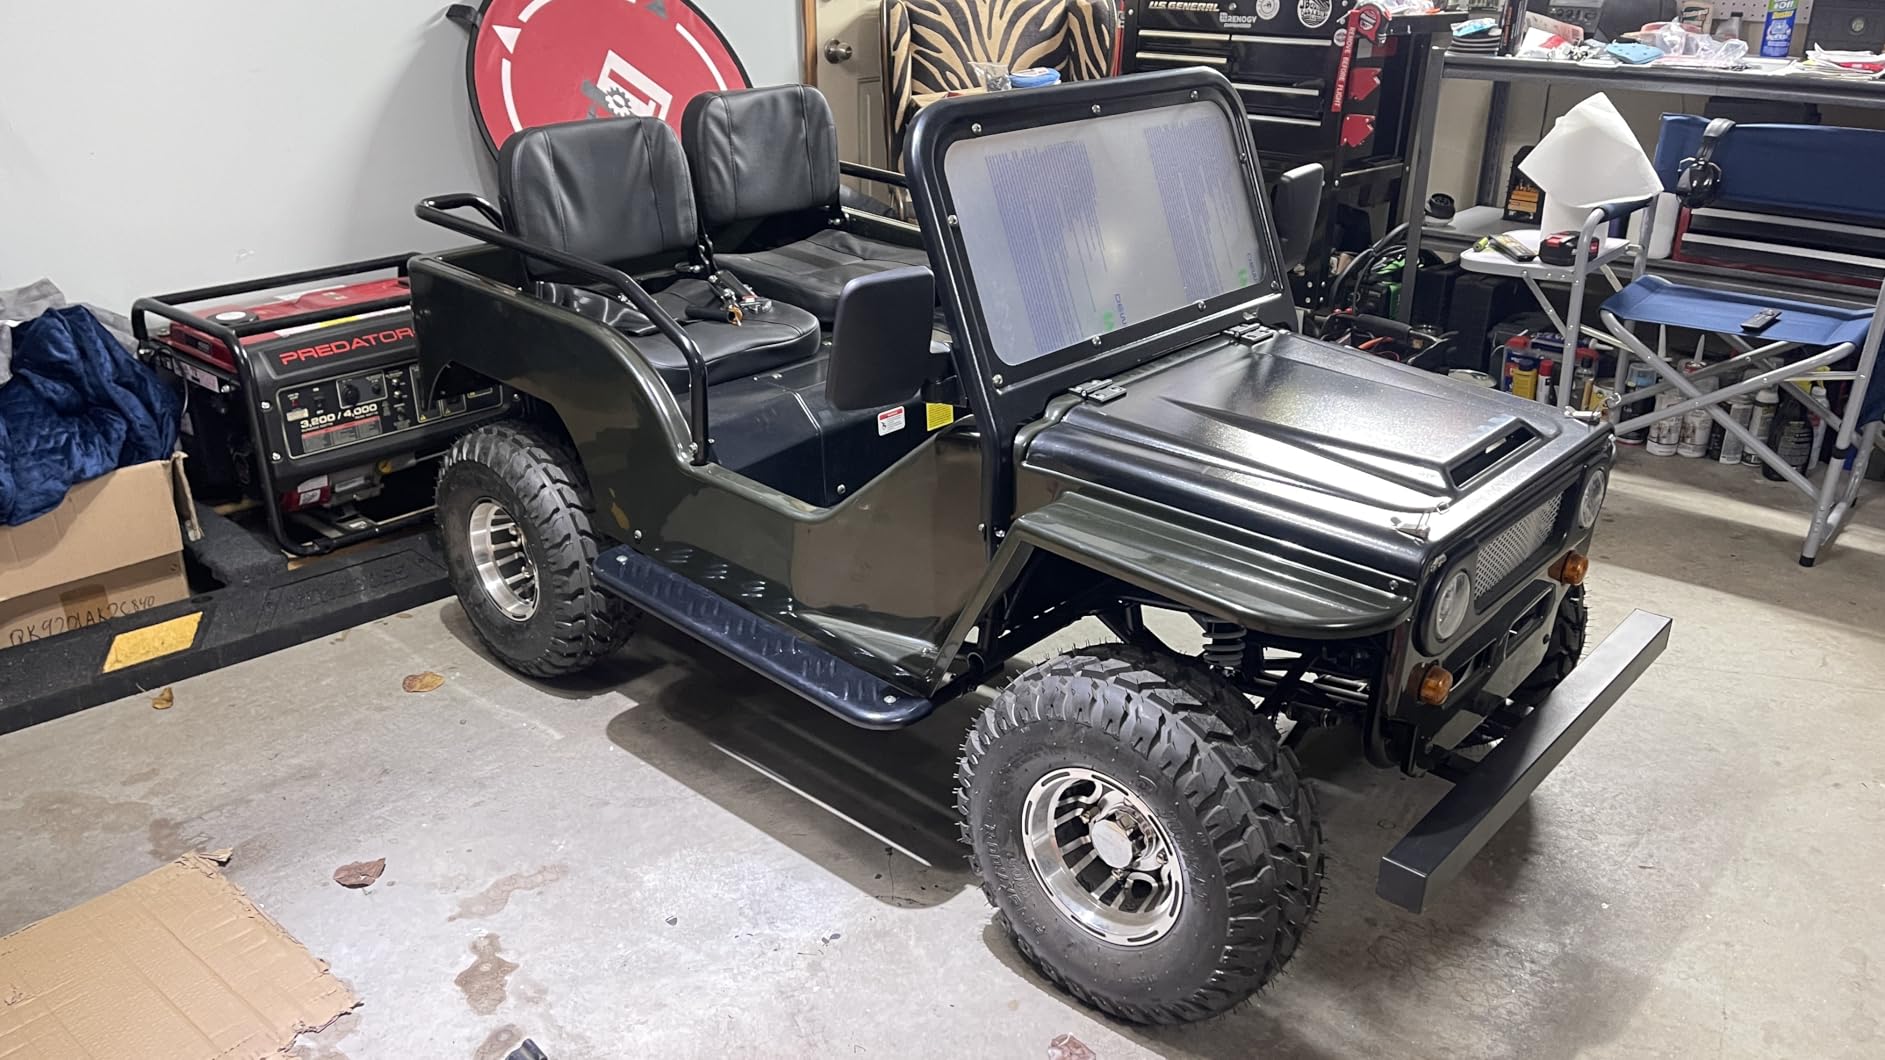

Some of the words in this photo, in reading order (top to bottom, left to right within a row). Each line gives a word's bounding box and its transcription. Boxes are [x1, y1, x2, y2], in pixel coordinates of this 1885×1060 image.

[1167, 2, 1221, 12] GENERAL
[1228, 15, 1258, 23] RENOGY
[1344, 26, 1356, 54] REMOVE
[1339, 56, 1350, 81] BEFORE
[1334, 84, 1344, 107] FLIGHT
[279, 326, 415, 366] PREDATOR
[300, 413, 336, 429] 3,200
[343, 403, 378, 418] 4,000
